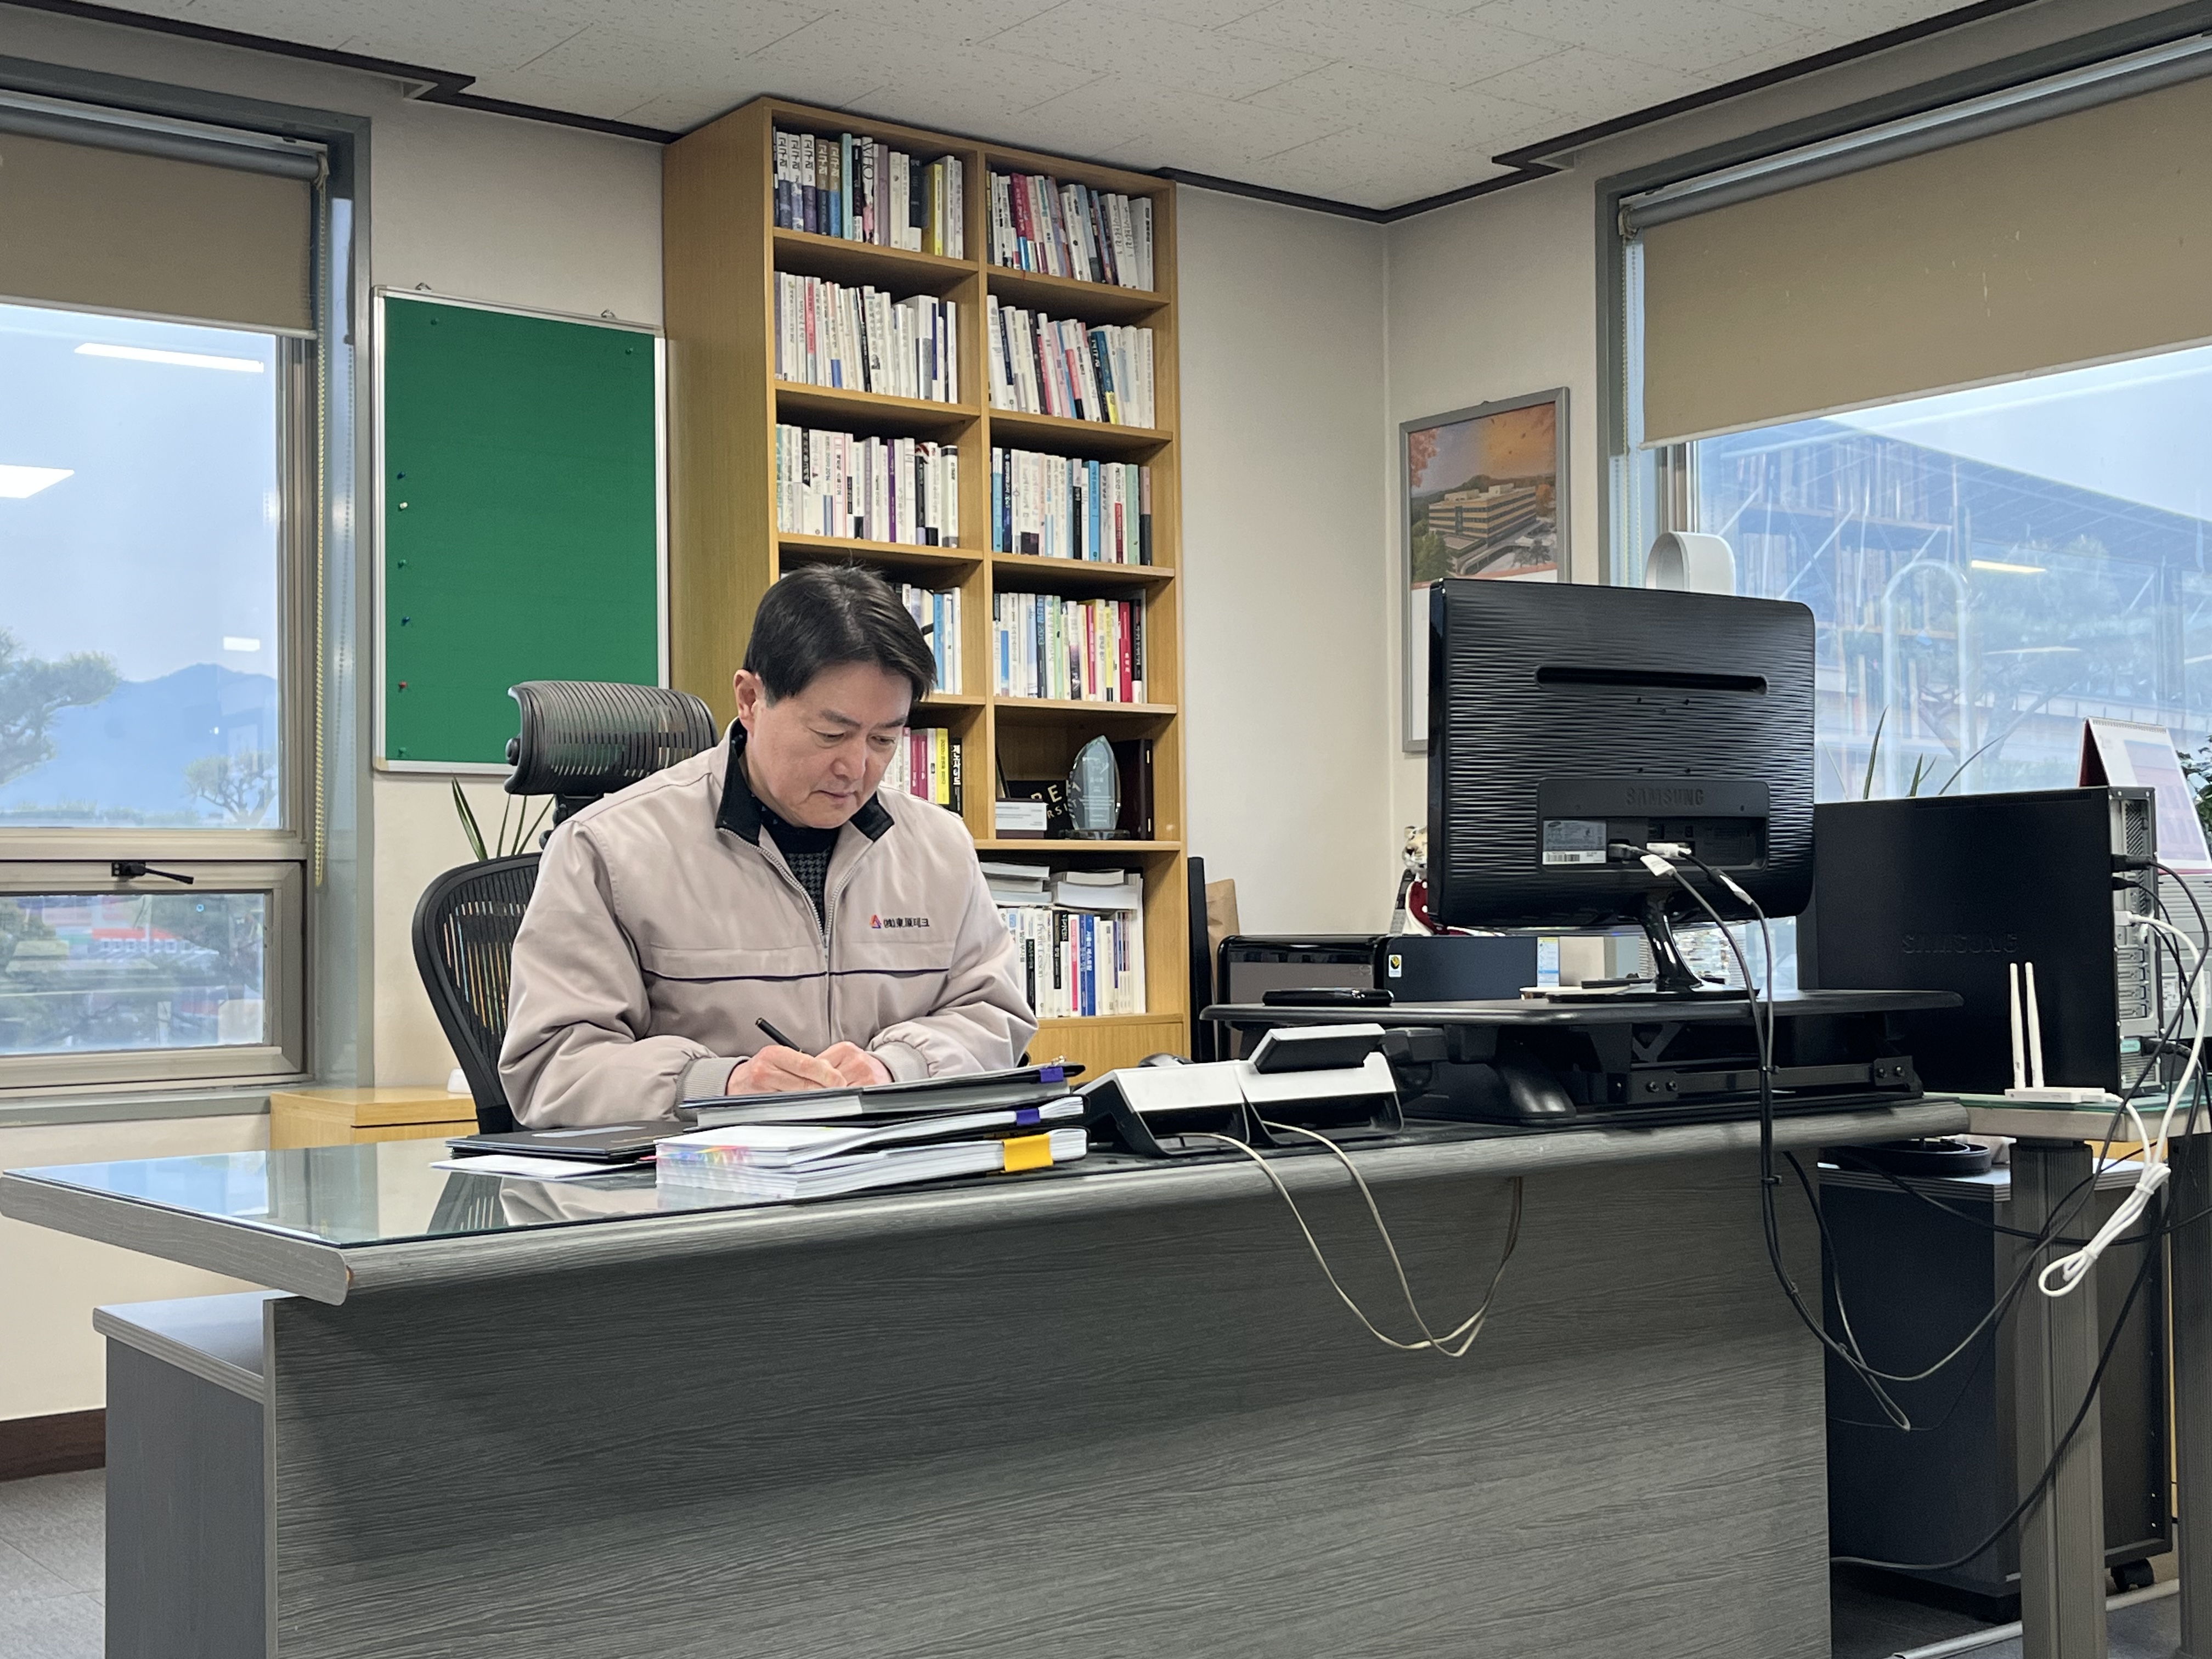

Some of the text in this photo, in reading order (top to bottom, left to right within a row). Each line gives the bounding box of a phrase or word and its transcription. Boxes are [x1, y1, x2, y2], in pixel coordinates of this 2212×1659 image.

[778, 137, 788, 167] 고구려
[791, 139, 800, 170] 고구려
[804, 139, 814, 170] 고구려
[818, 144, 828, 176] 고구려
[831, 146, 840, 178] 고구려
[1625, 787, 1703, 806] SAMSUNG
[1901, 934, 2018, 954] SAMSUNG
